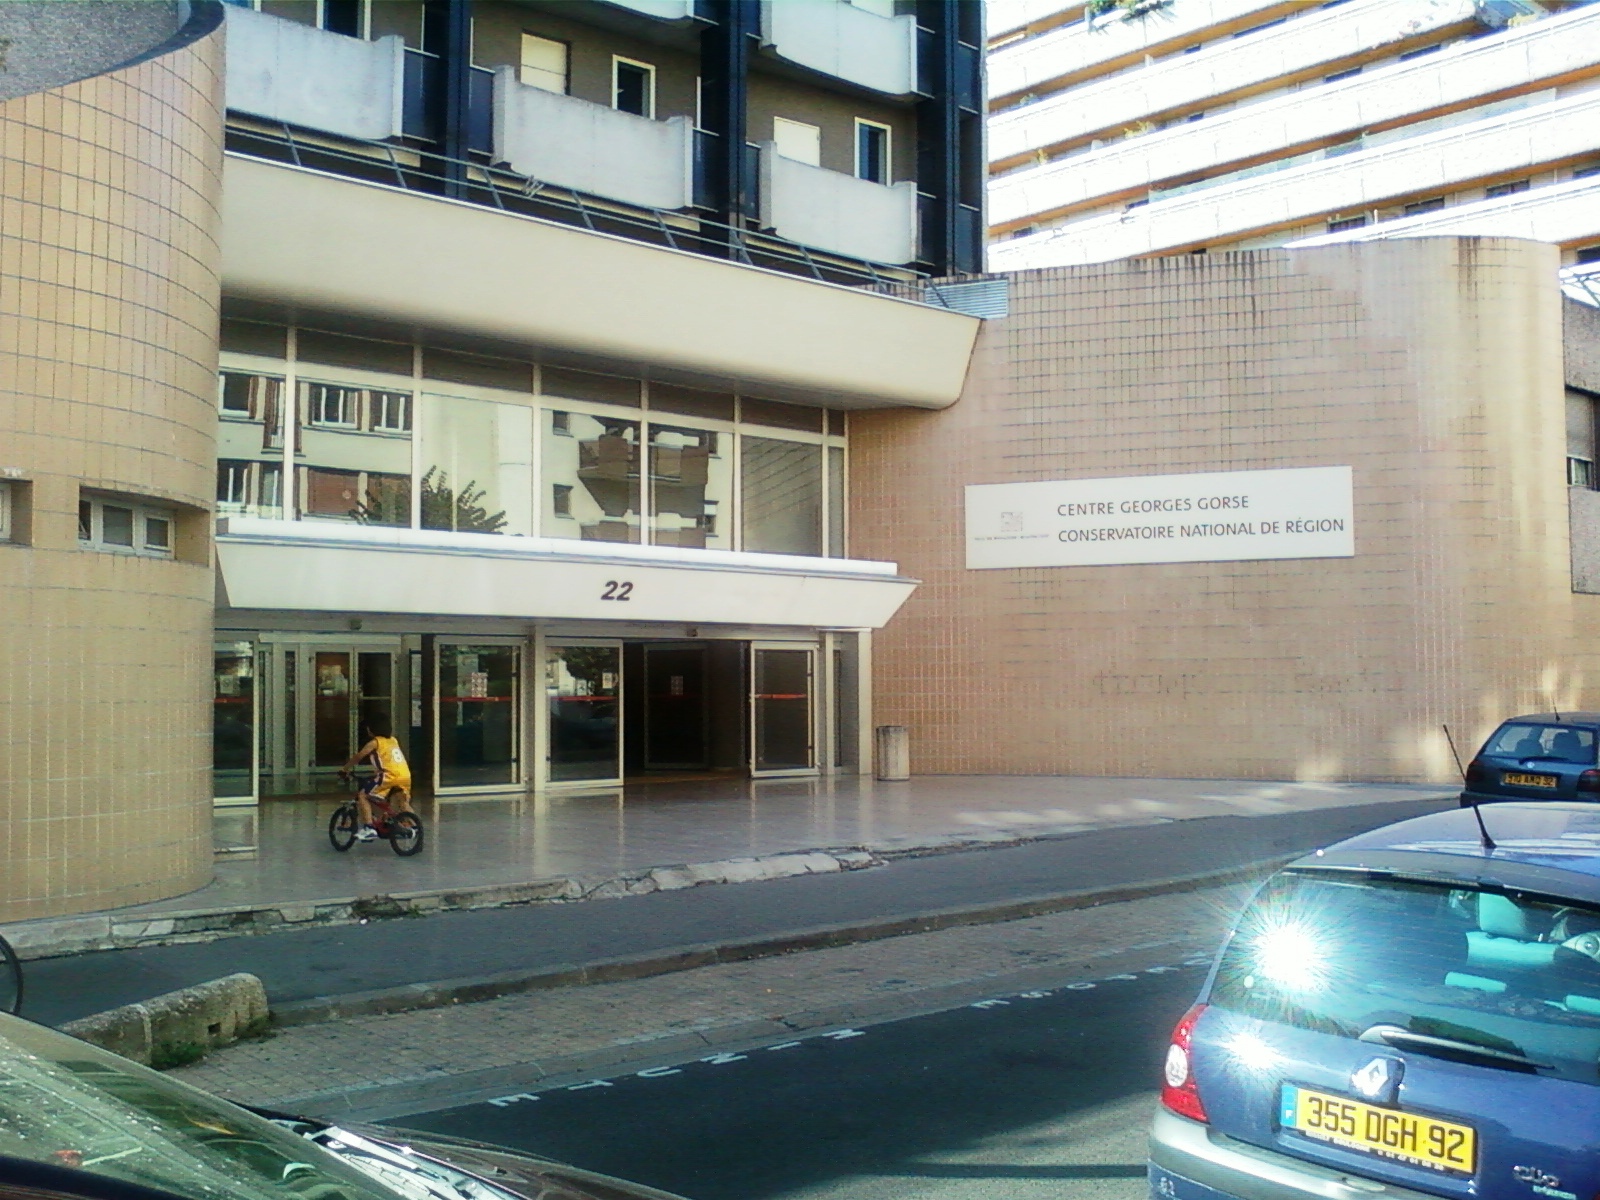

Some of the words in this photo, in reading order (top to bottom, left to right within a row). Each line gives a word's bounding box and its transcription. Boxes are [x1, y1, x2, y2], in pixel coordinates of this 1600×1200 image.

[1057, 502, 1115, 516] CENTRE
[1120, 498, 1192, 513] GEORGES
[1197, 495, 1249, 510] GORSE
[1058, 525, 1175, 542] CONSERVATOIRE
[1180, 522, 1256, 538] NATIONAL
[1260, 521, 1280, 535] DE
[1285, 517, 1344, 534] RÉGION
[600, 580, 634, 601] 22
[391, 748, 403, 763] 8
[1307, 1096, 1356, 1136] 355
[1365, 1109, 1418, 1152] DGH
[1428, 1125, 1466, 1163] 92
